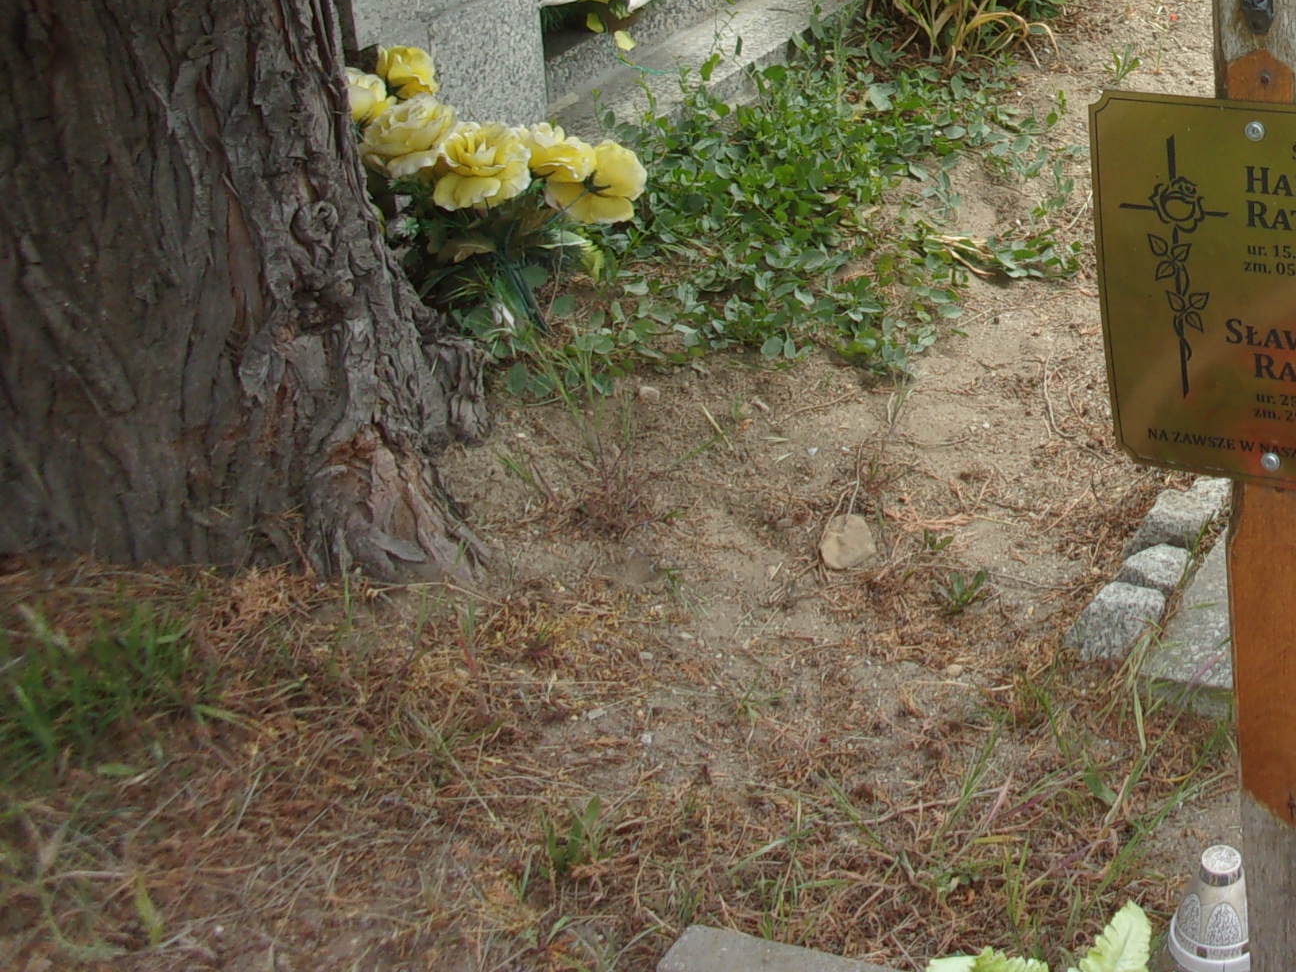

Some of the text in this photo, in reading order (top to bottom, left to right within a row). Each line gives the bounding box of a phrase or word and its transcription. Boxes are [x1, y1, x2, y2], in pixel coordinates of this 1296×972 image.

[1248, 245, 1267, 257] ur.
[1244, 261, 1271, 274] zm.
[1148, 427, 1169, 442] NA
[1172, 431, 1236, 451] ZAWSZE
[1240, 440, 1254, 453] W
